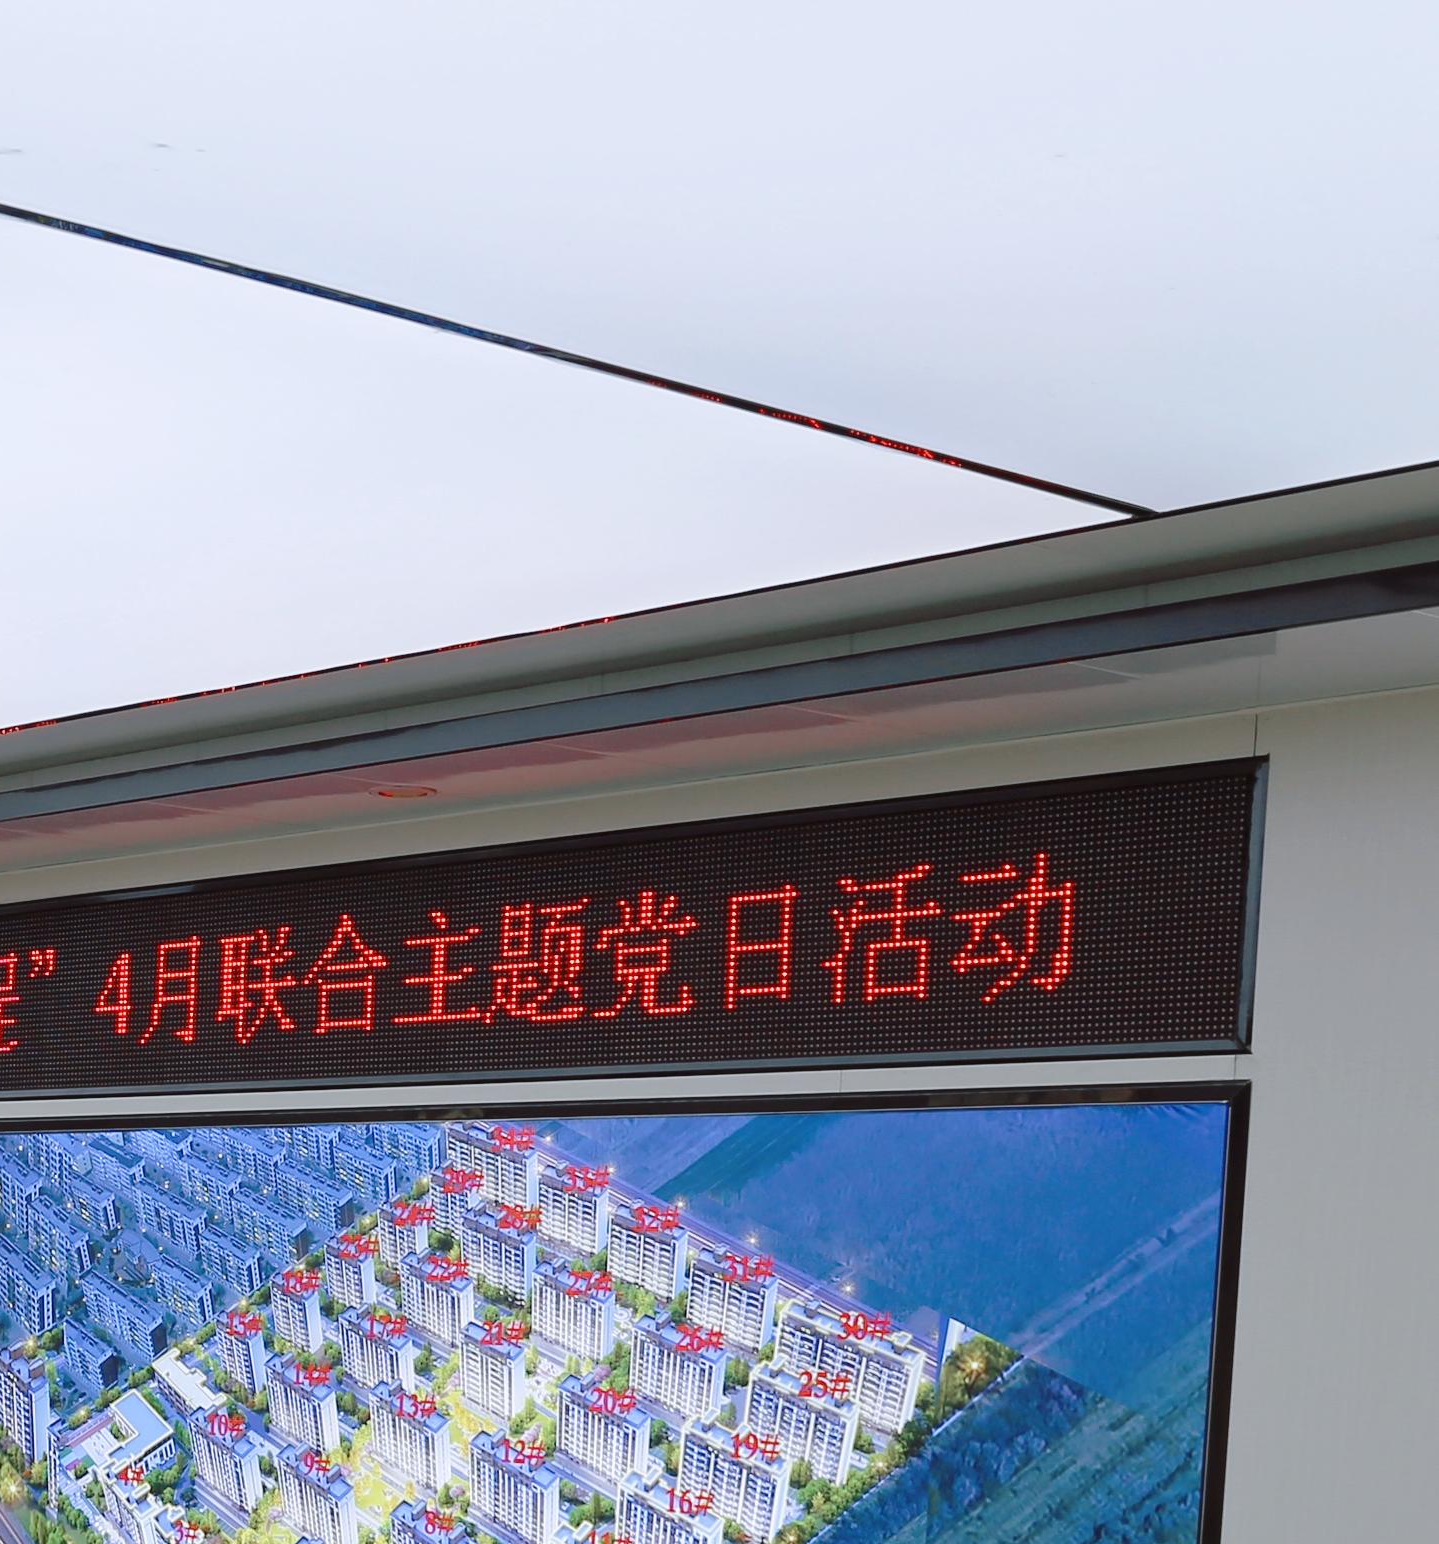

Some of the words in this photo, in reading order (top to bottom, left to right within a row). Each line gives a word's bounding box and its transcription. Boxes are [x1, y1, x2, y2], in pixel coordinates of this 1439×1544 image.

[93, 852, 1077, 1045] 4月联合主题党日活动
[723, 1254, 774, 1282] 31#
[366, 1315, 408, 1340] 17#
[480, 1321, 526, 1346] 21#
[676, 1324, 723, 1352] 26#
[837, 1312, 892, 1341] 30#
[798, 1371, 852, 1398] 25#
[396, 1393, 438, 1418] 13#
[589, 1387, 637, 1414] 20#
[501, 1440, 545, 1466] 12#
[731, 1433, 781, 1460] 19#
[303, 1452, 331, 1475] 9#
[666, 1488, 714, 1515] 16#
[425, 1511, 455, 1535] 8#
